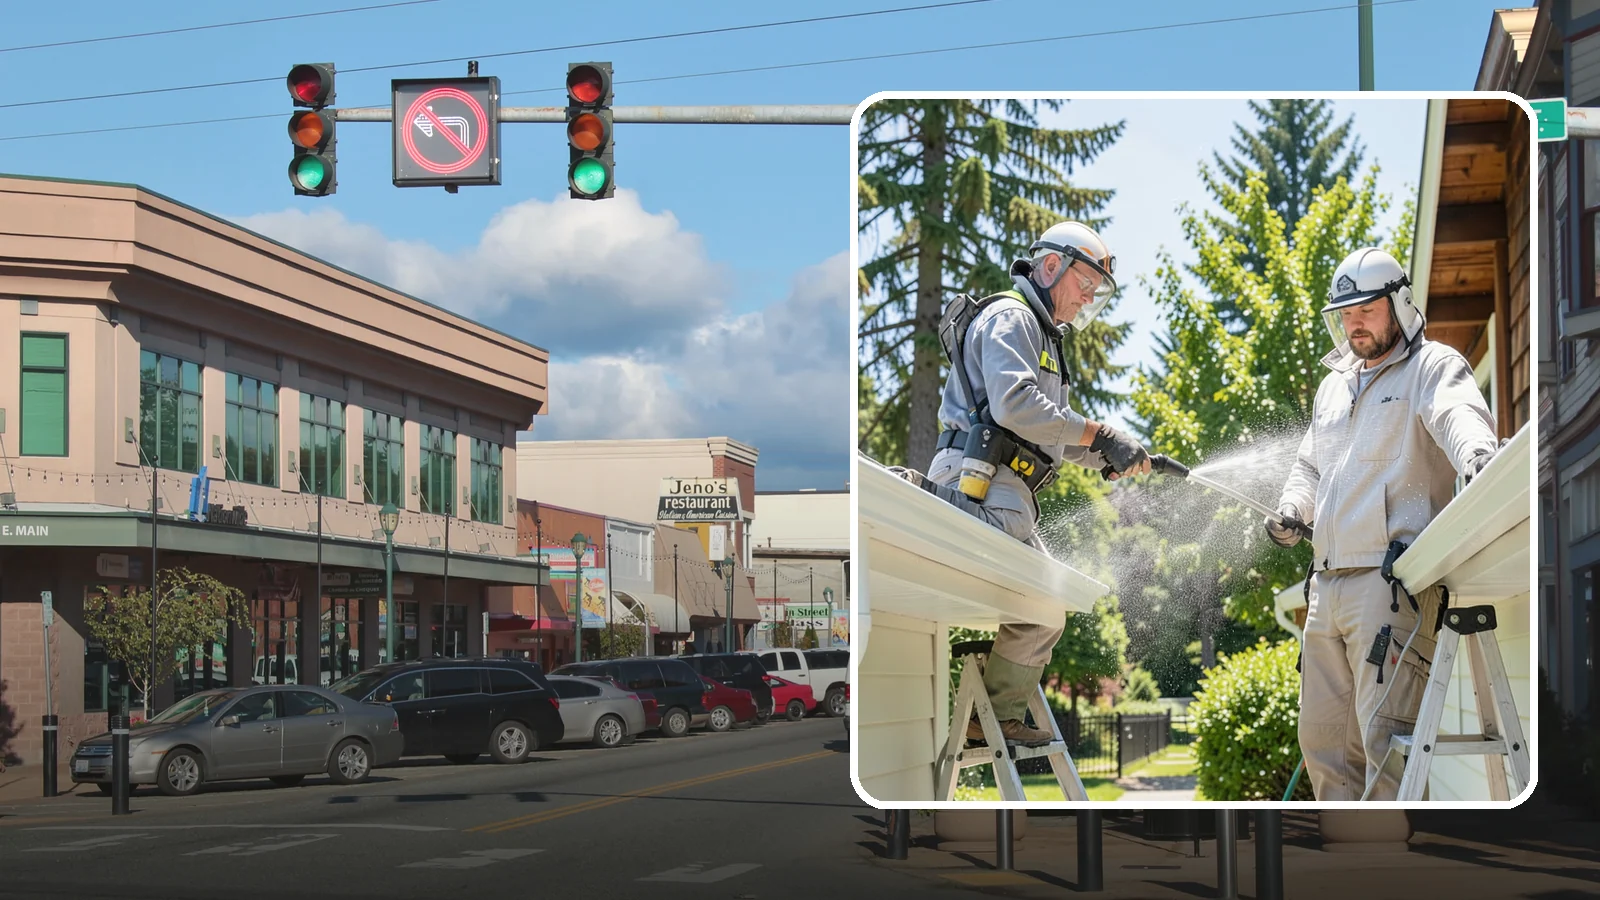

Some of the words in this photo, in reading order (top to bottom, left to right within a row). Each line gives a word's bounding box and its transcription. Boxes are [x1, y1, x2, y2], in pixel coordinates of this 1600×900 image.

[669, 480, 728, 495] Jeno's
[664, 496, 731, 509] restaurant
[658, 510, 681, 520] Italian
[686, 510, 714, 520] American
[715, 510, 738, 520] Cuisine
[2, 525, 13, 536] E.
[15, 525, 49, 536] MAIN
[797, 607, 828, 617] Street
[790, 619, 823, 627] lass
